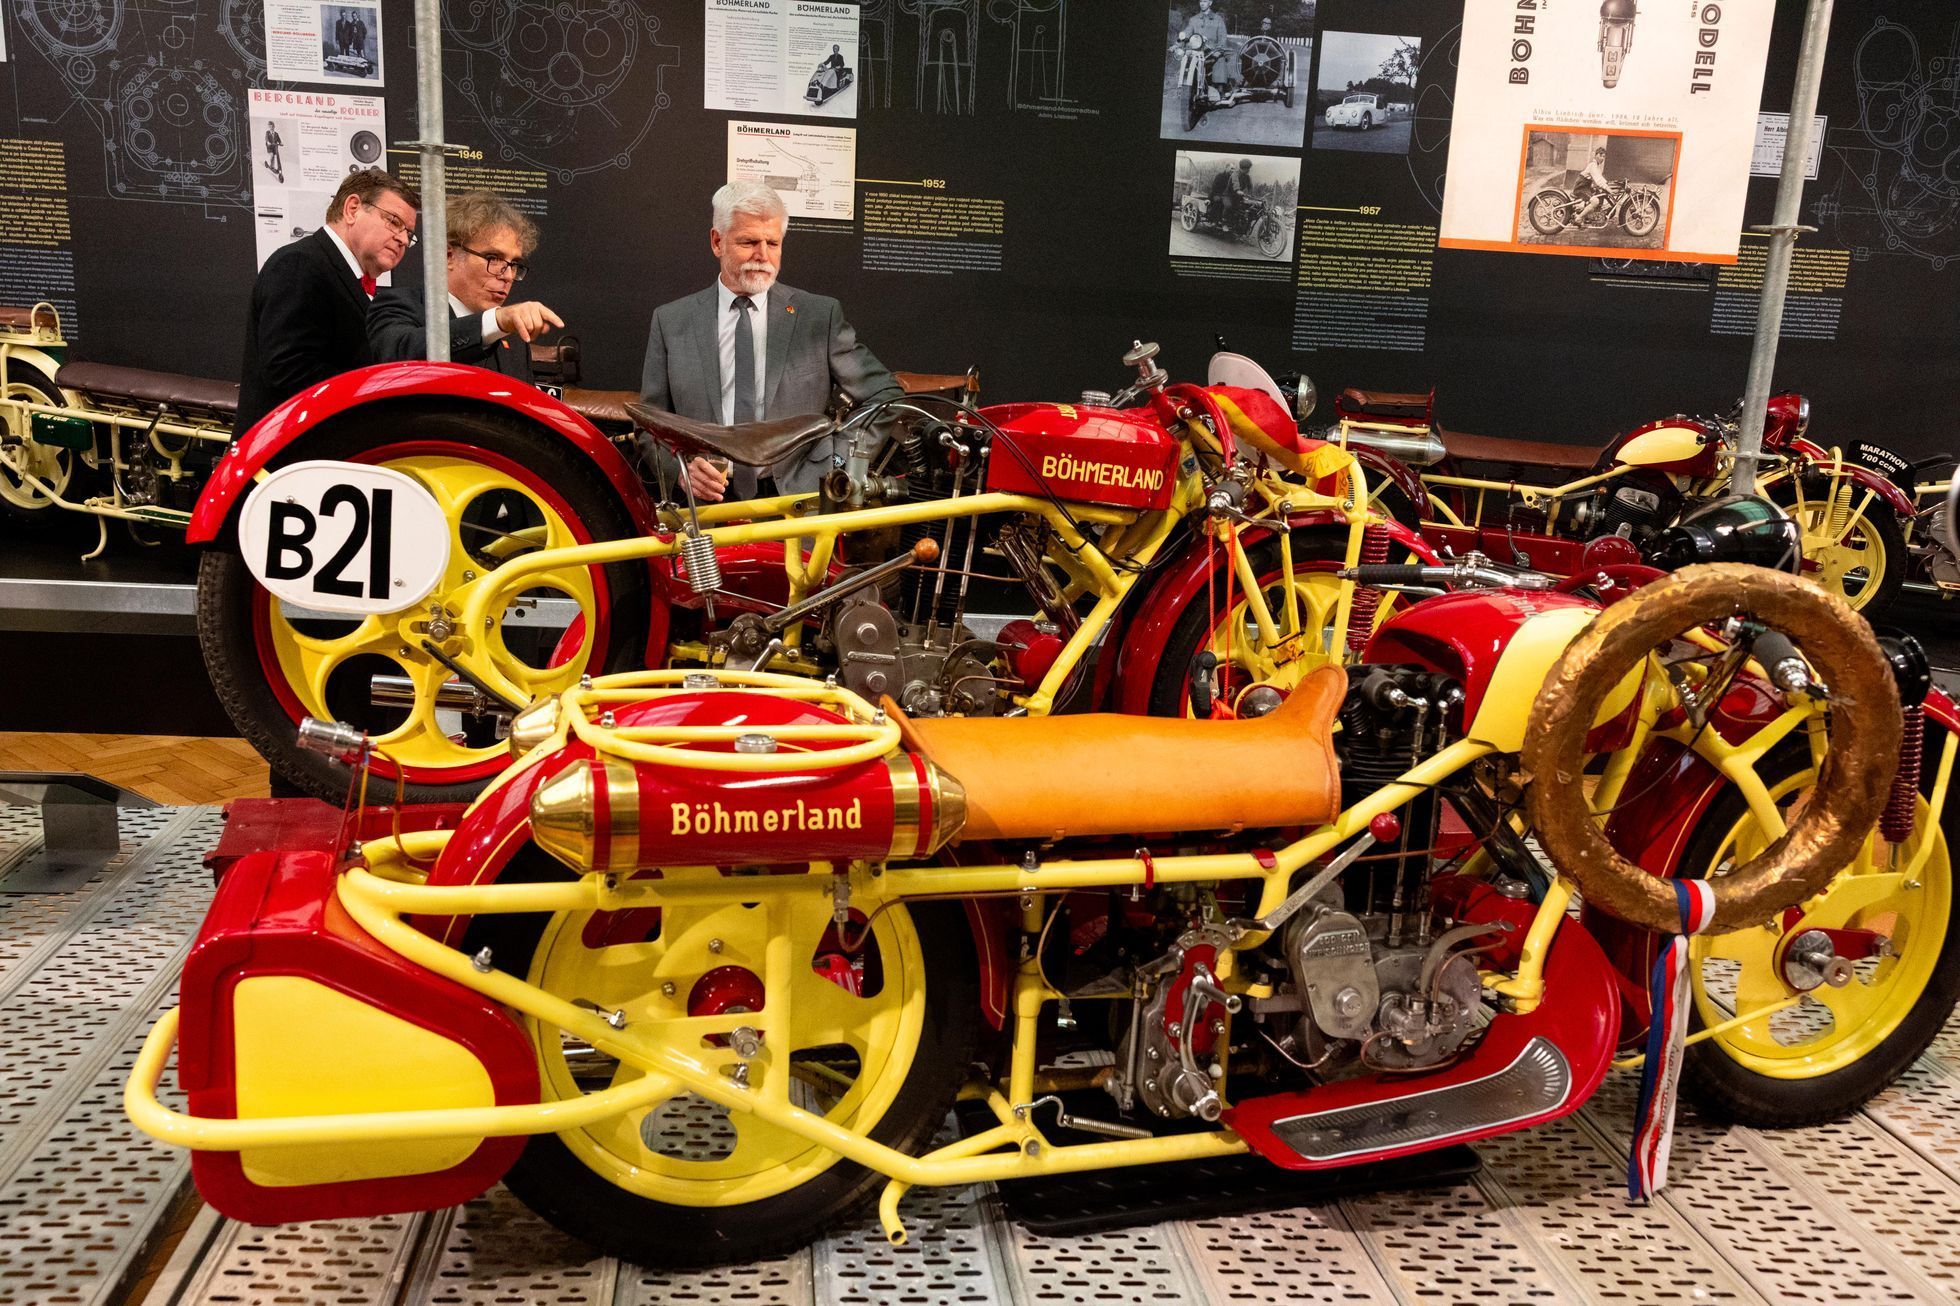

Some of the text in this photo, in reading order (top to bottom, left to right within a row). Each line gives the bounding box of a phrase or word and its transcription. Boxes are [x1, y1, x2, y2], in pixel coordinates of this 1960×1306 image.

[797, 4, 851, 14] BÖHMERLAND
[1690, 0, 1723, 94] ODELL
[254, 92, 336, 107] BERGLAND
[340, 106, 380, 117] ROLLER
[737, 125, 790, 136] BÖHMERLAND
[458, 150, 483, 159] 1946
[922, 179, 946, 188] 1952
[1359, 206, 1382, 215] 1957
[1860, 443, 1908, 470] MARATHON
[1862, 452, 1896, 473] 700 ccm
[1042, 452, 1164, 490] BÖHMERLAND
[265, 483, 393, 600] B21
[670, 796, 863, 836] Böhmerland
